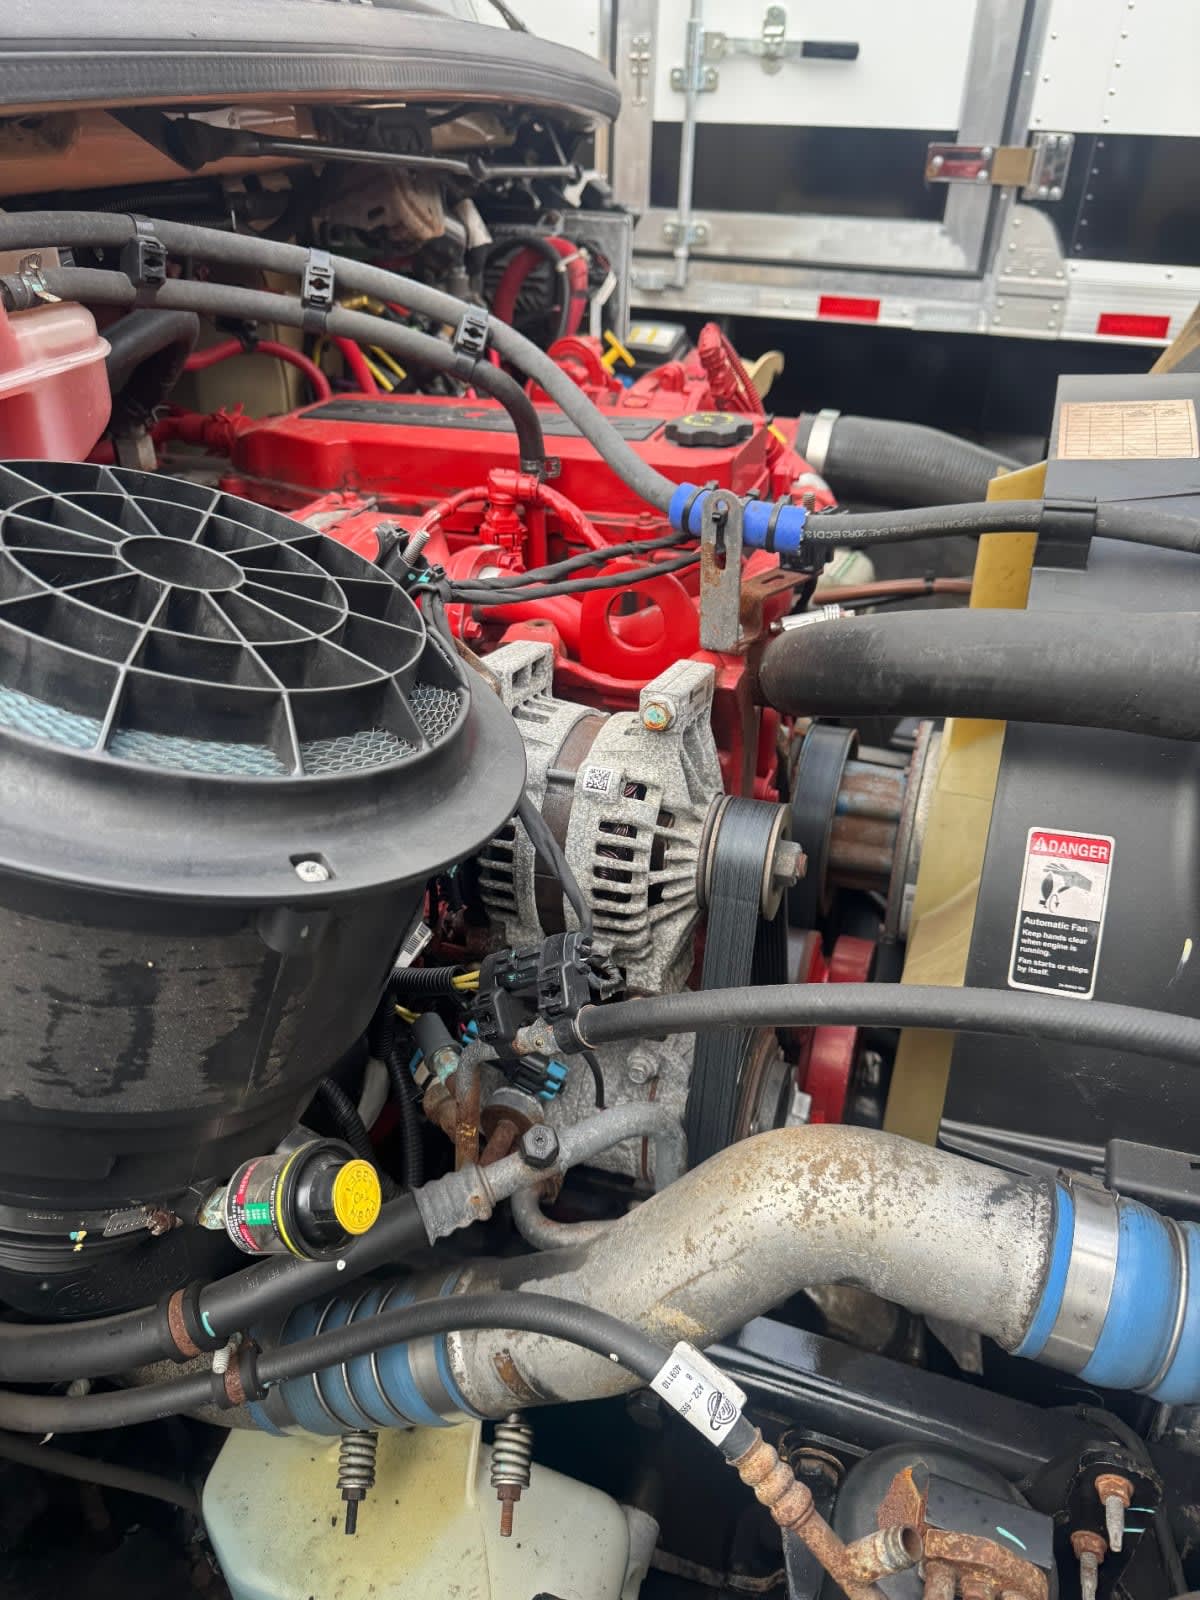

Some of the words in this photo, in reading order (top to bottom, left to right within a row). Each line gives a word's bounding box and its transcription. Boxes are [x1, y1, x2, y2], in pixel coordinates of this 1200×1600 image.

[1048, 839, 1108, 860] DANGER
[1023, 916, 1070, 930] Automatic
[1071, 923, 1088, 933] Fan
[1020, 938, 1042, 946] when
[1042, 941, 1068, 951] engine
[1070, 944, 1077, 952] is
[1022, 928, 1042, 939] Keep
[1043, 932, 1067, 942] hands
[1068, 936, 1088, 945] clear
[1019, 946, 1051, 957] running.
[1016, 964, 1027, 973] by
[1018, 956, 1032, 965] Fan
[1033, 960, 1056, 969] starts
[1066, 965, 1089, 974] stops
